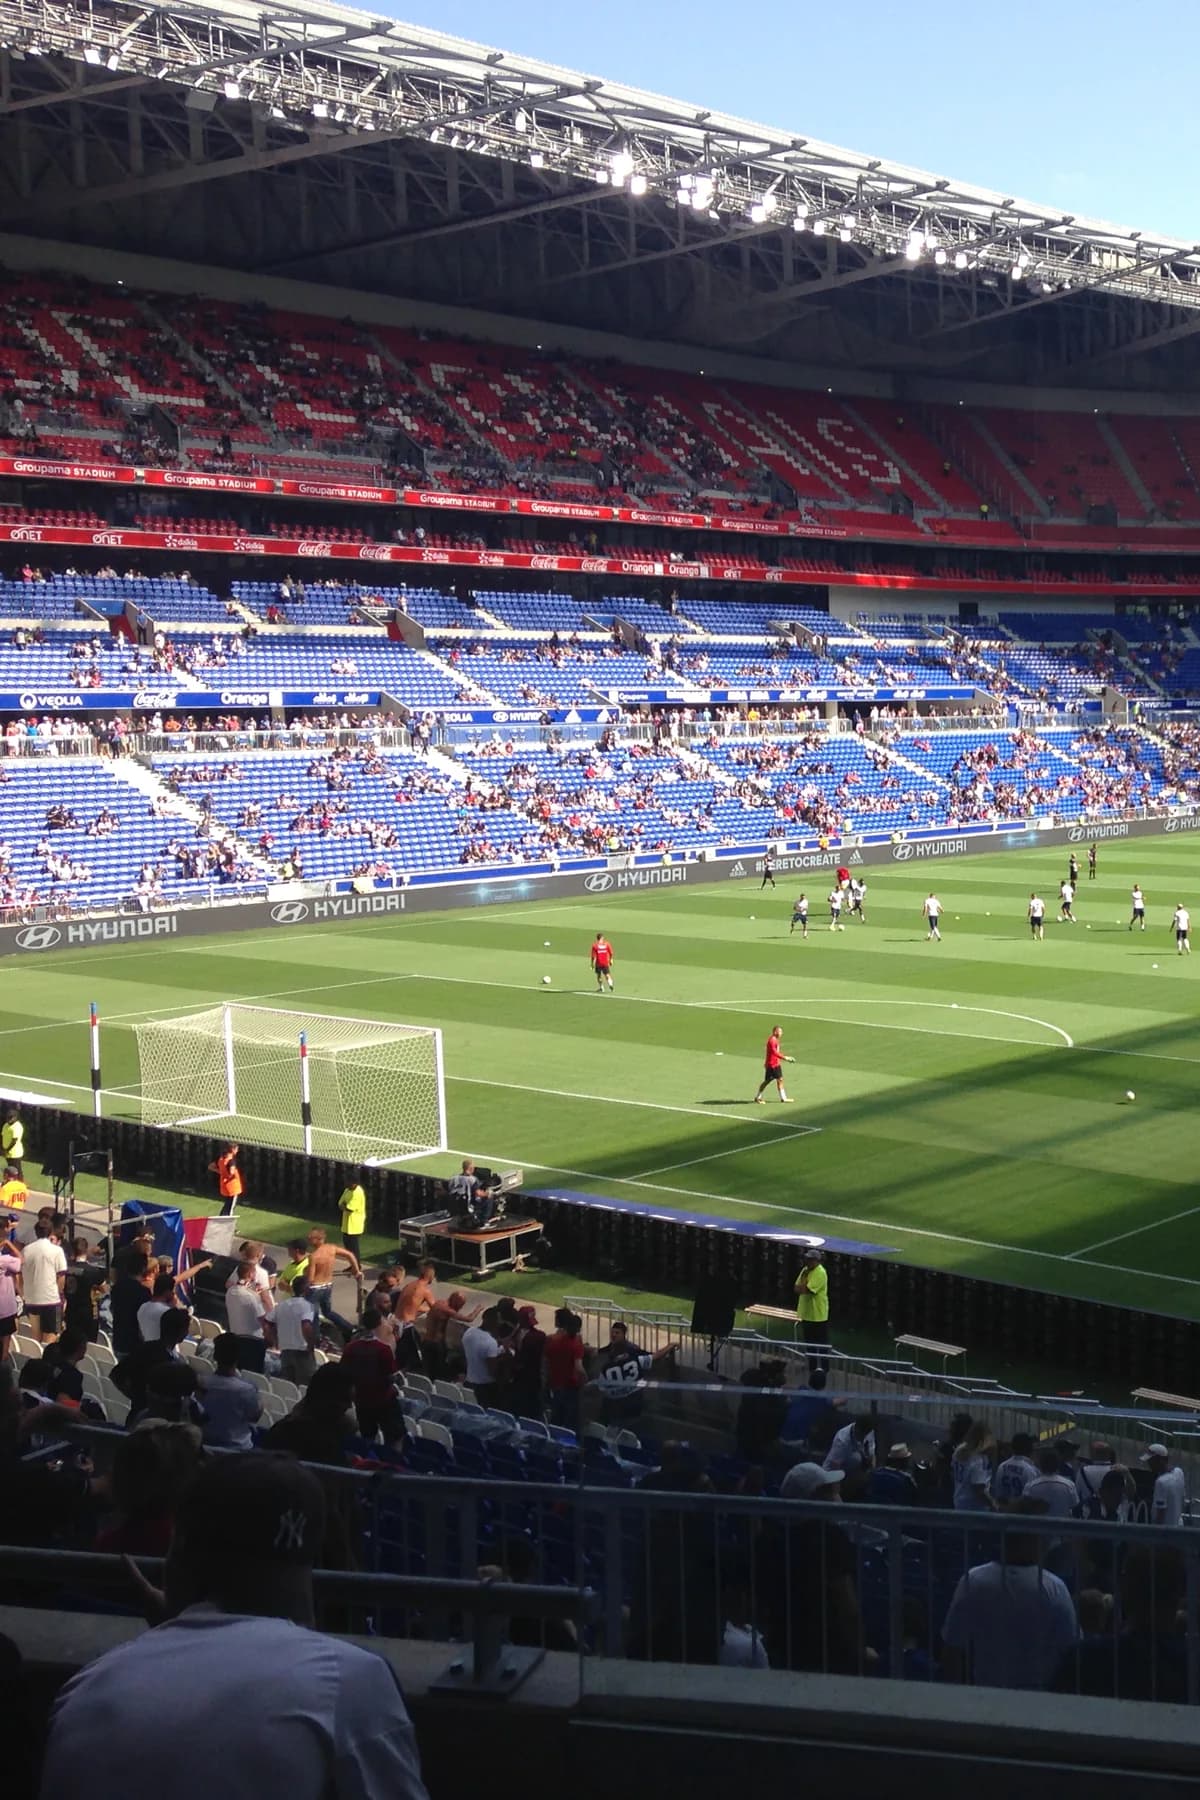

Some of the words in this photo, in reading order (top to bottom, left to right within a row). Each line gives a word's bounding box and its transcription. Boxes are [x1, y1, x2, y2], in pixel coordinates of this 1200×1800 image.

[14, 461, 70, 476] Groupama
[74, 468, 116, 479] STADIUM
[164, 473, 216, 487] Groupama
[218, 480, 257, 489] STADIUM
[299, 484, 346, 497] Groupama
[347, 490, 382, 500] STADIUM
[420, 494, 463, 506] Groupama
[464, 501, 496, 509] STADIUM
[531, 503, 570, 515] Groupama
[571, 508, 600, 516] STADIUM
[631, 512, 666, 524] Groupama
[667, 517, 693, 525] STADIUM
[721, 519, 754, 531] Groupama
[622, 563, 654, 576] Orange
[669, 566, 700, 577] Orange
[221, 691, 268, 705] Orange
[1086, 823, 1129, 839] HYUNDAI
[916, 840, 967, 857] HYUNDAI
[617, 866, 687, 888] HYUNDAI
[314, 893, 407, 918] HYUNDAI
[67, 915, 177, 943] HYUNDAI
